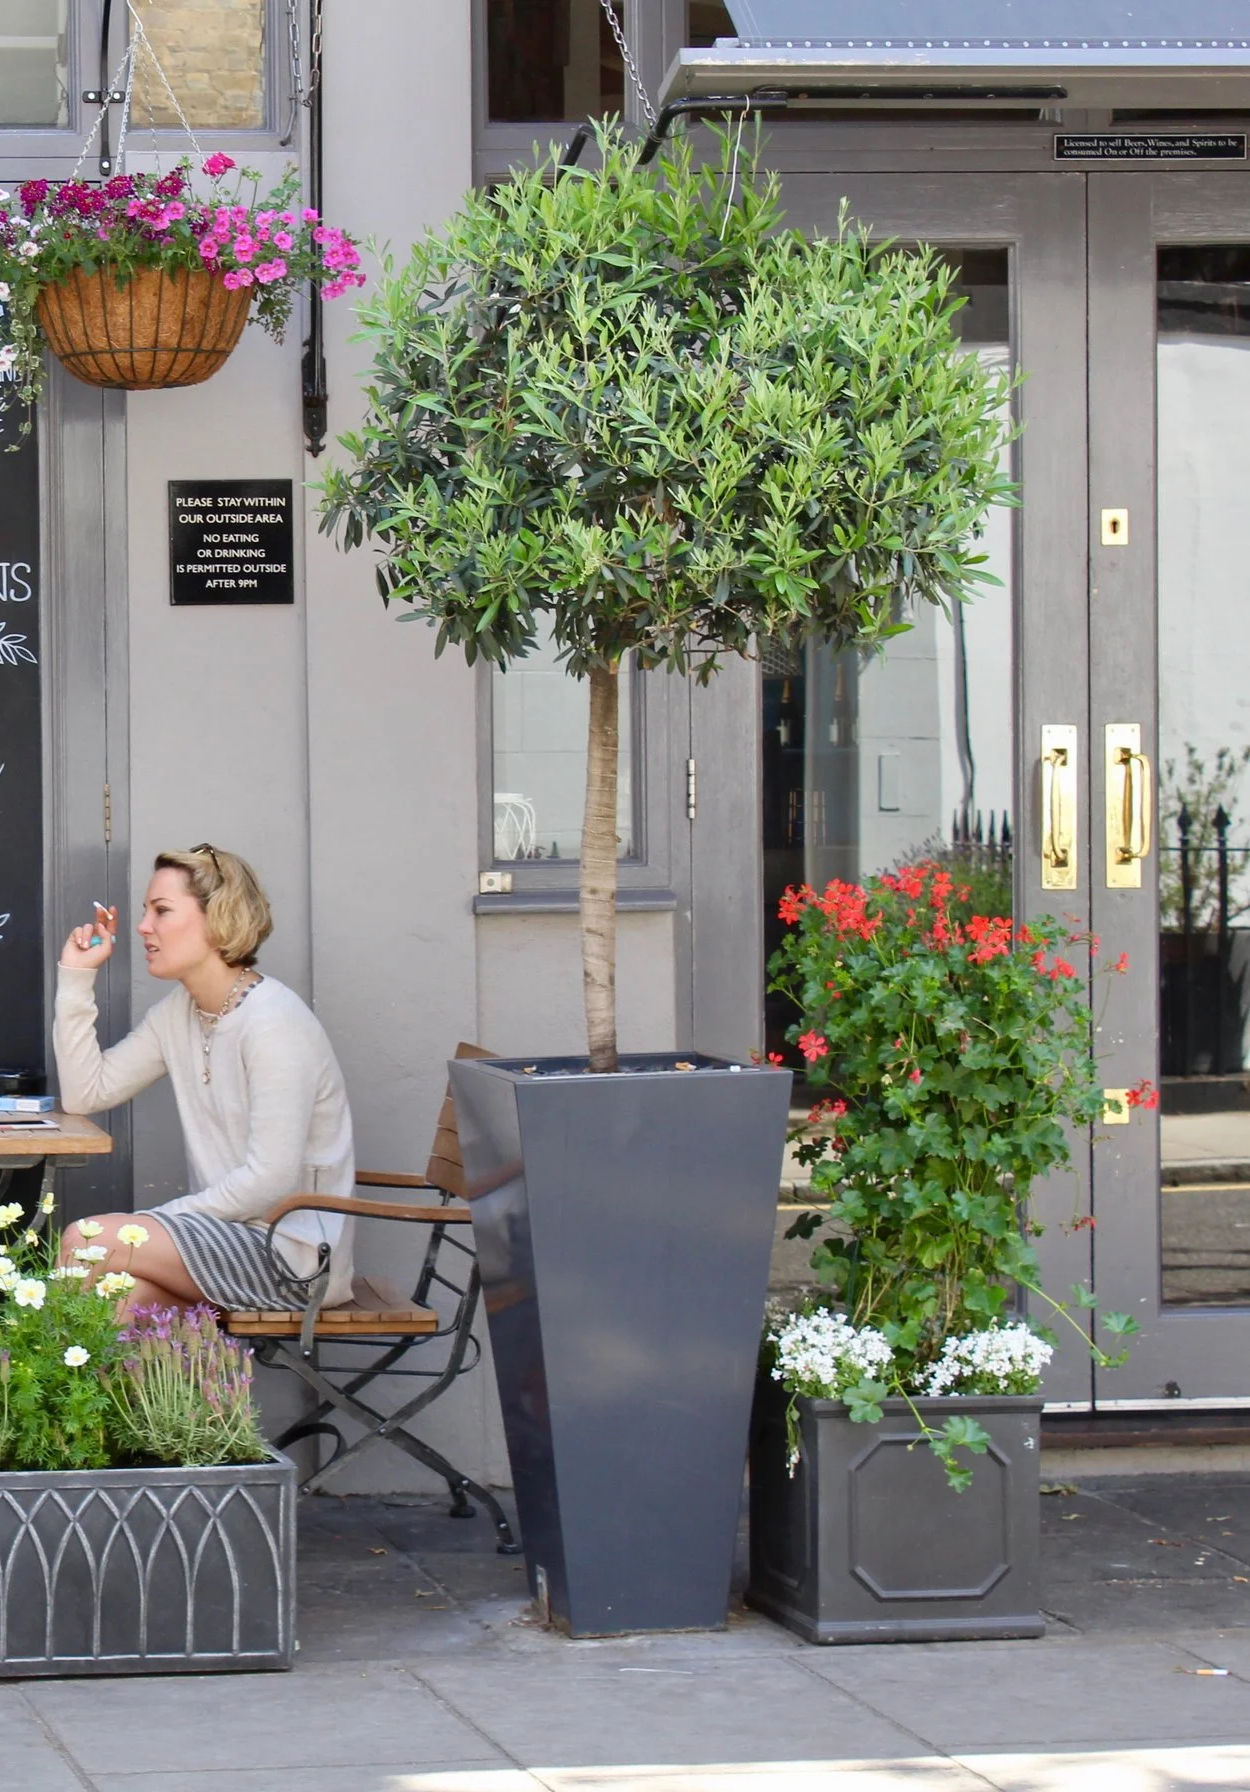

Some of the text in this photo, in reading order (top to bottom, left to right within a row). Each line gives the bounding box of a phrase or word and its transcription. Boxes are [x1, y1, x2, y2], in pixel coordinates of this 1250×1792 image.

[1063, 138, 1098, 147] Licensed
[1099, 139, 1108, 147] to
[1109, 138, 1122, 147] sell
[1174, 138, 1190, 147] and
[1191, 138, 1217, 148] Spirits
[1218, 139, 1226, 147] to
[1227, 138, 1238, 147] be
[1063, 147, 1102, 156] consumed
[1104, 147, 1118, 156] On
[1118, 148, 1127, 156] or
[1129, 147, 1144, 156] Off
[1145, 147, 1158, 156] the
[176, 497, 286, 507] PLEASE STAY WITHIN
[178, 514, 284, 524] OUR OUTSIDE AREA
[203, 533, 260, 543] NO EATING
[197, 549, 266, 558] OR DRINKING
[176, 563, 287, 573] IS PERMITTED OUTSIDE
[205, 579, 258, 588] AFTER 9PM
